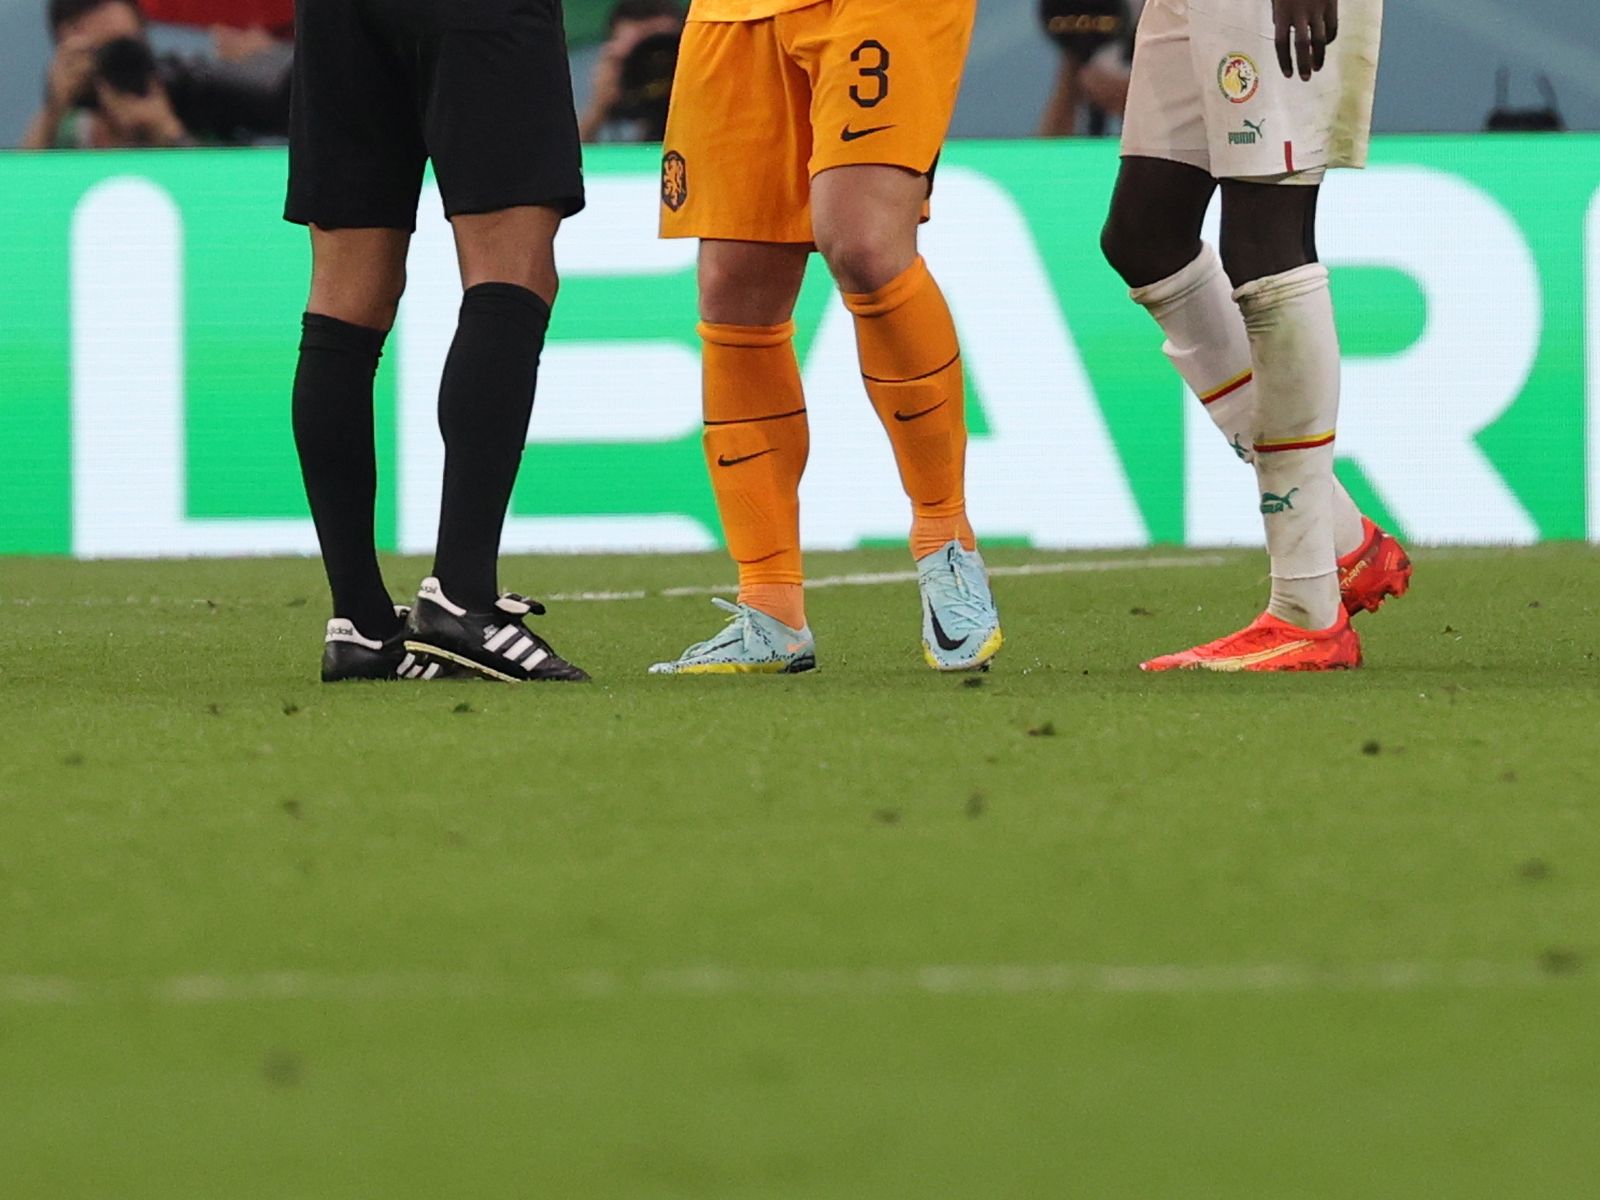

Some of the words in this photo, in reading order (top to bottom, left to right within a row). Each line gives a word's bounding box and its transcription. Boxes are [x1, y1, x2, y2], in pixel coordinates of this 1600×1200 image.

[849, 39, 890, 108] 3
[1227, 131, 1256, 145] PUMA
[70, 164, 1600, 561] LEAR
